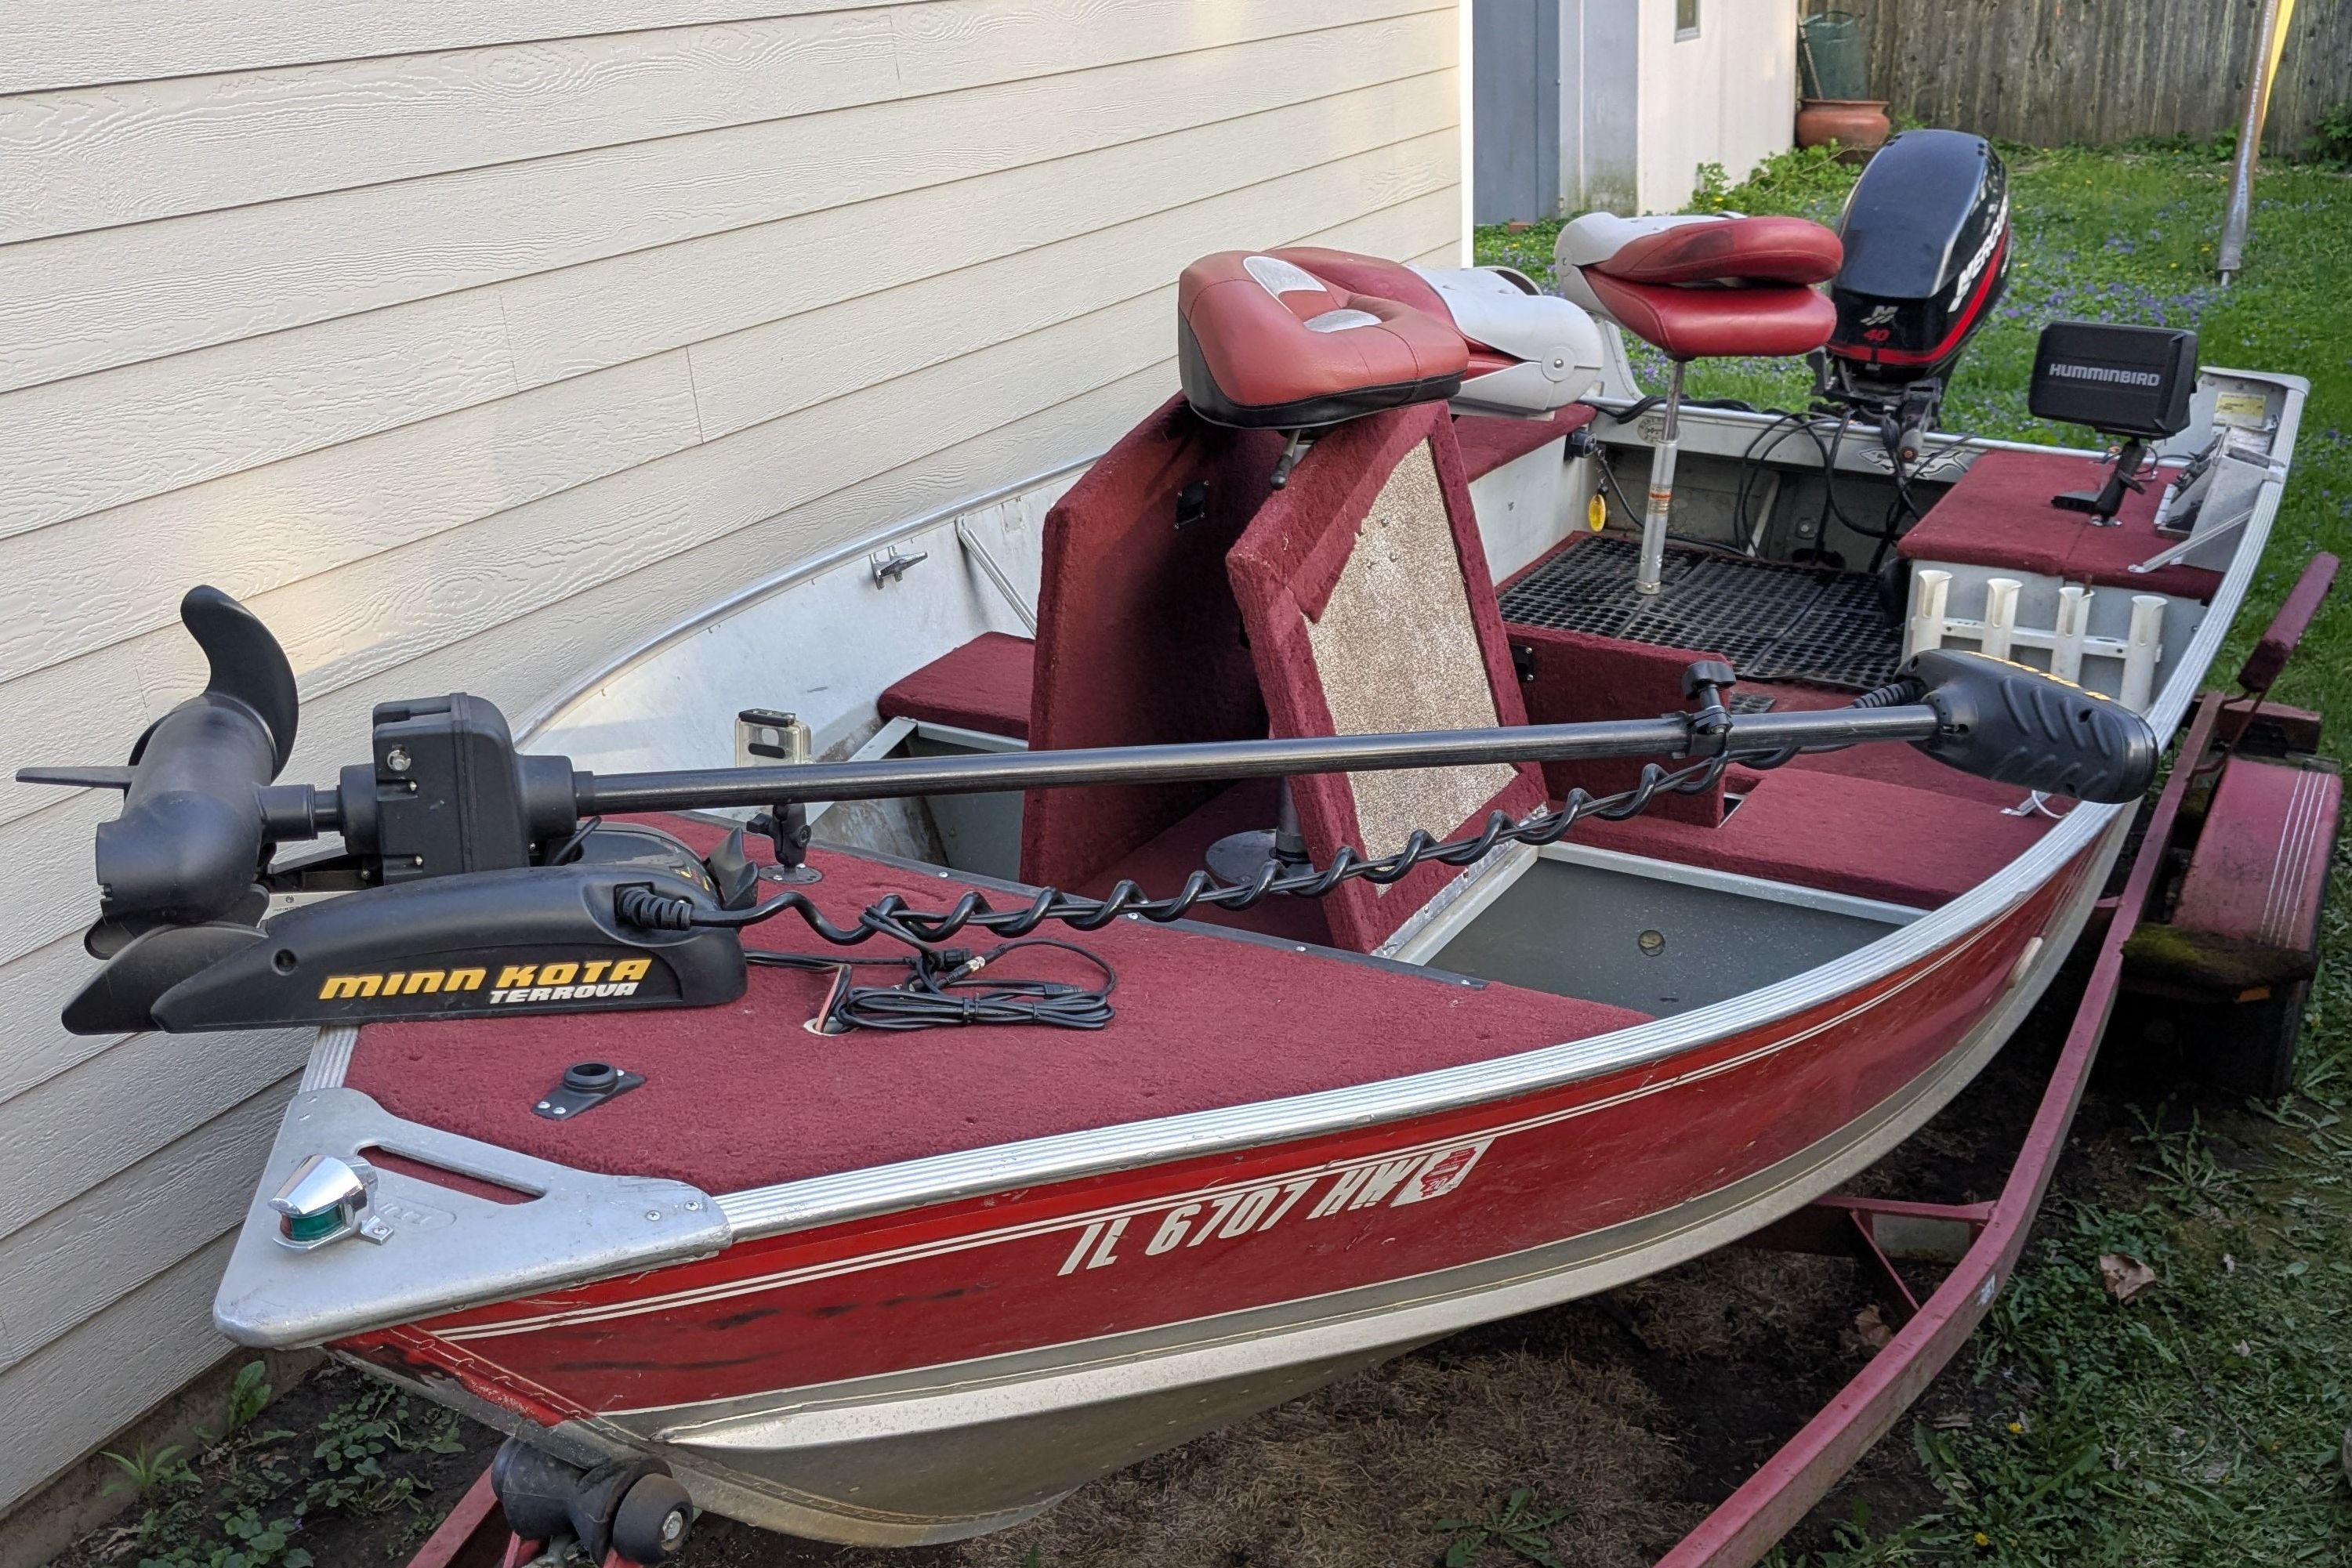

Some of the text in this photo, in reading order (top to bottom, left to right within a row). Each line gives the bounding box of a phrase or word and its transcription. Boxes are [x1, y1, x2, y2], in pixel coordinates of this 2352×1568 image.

[1864, 329, 1890, 342] 40
[2049, 363, 2162, 387] HUMMINBIRD
[318, 958, 653, 1000] MINN KOTA
[490, 982, 640, 1005] TERROVA
[1056, 1154, 1430, 1276] IL 6707 HW
